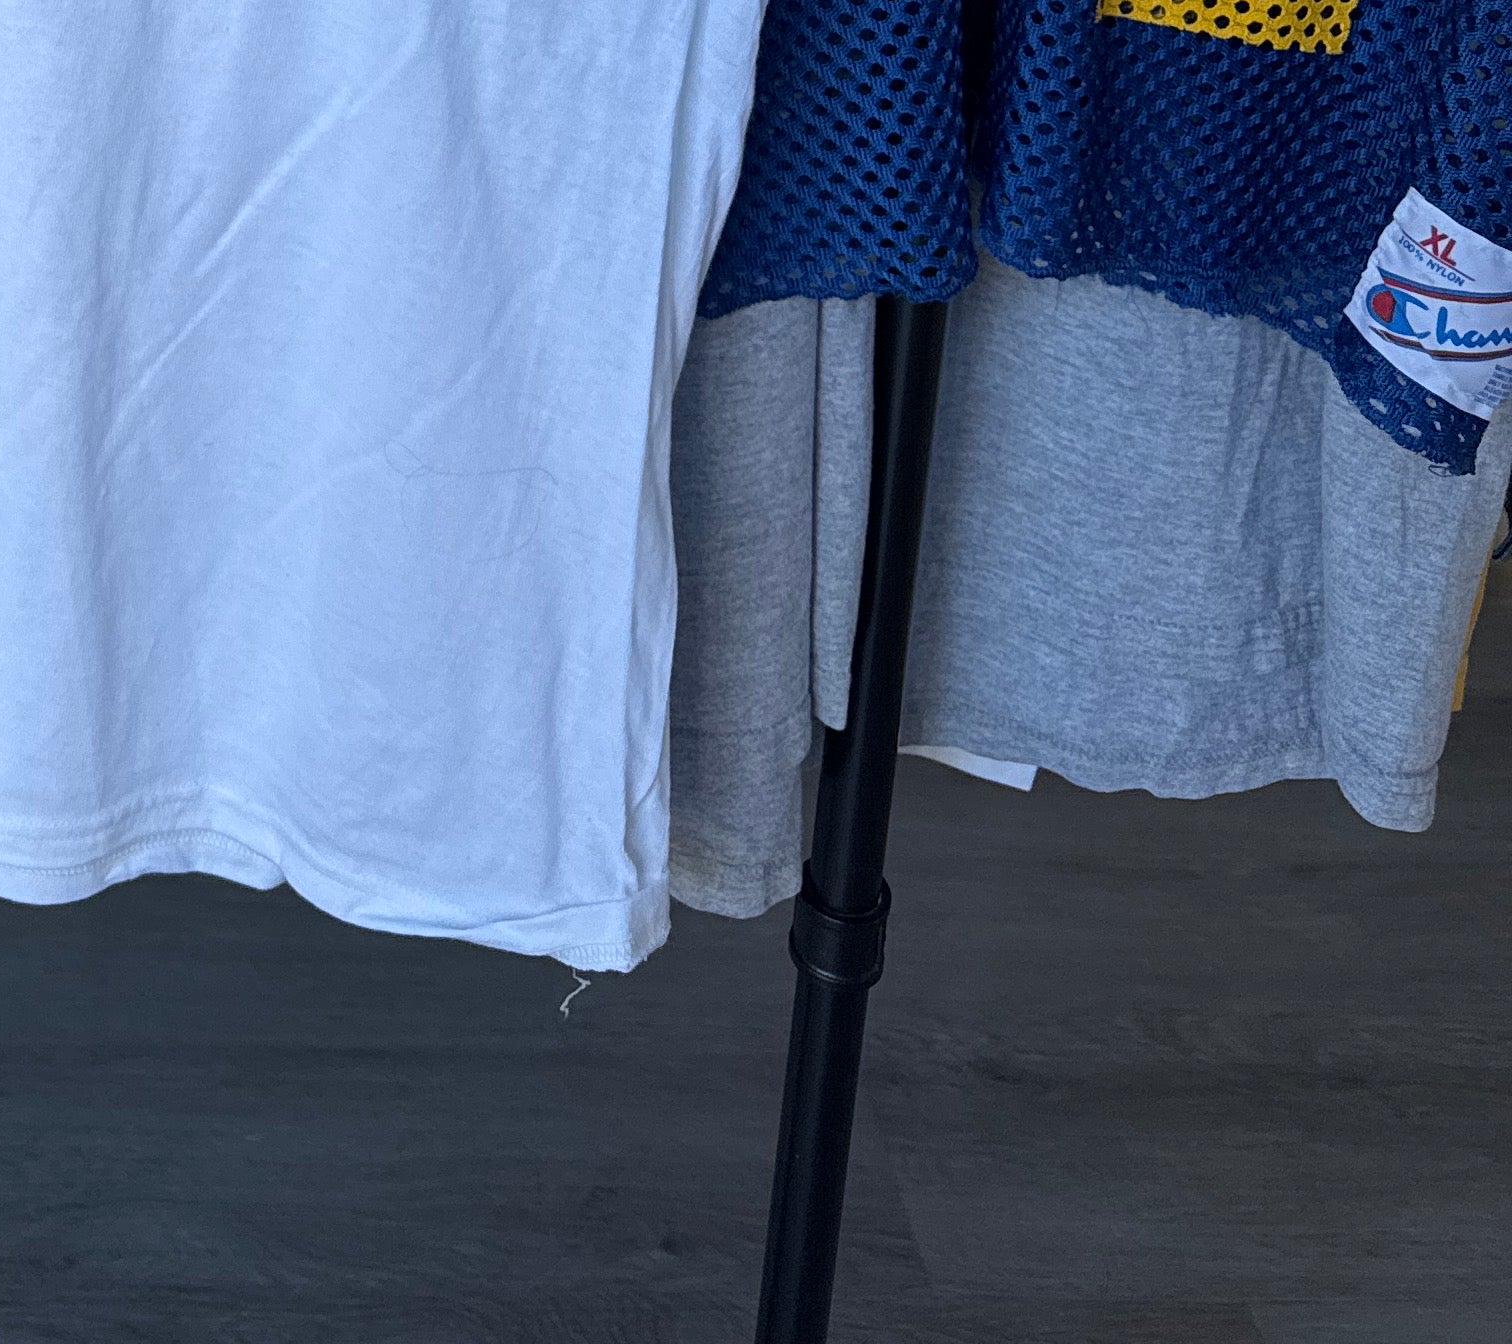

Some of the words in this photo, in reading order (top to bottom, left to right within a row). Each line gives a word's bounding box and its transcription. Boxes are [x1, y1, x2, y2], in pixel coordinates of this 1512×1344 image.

[1398, 235, 1424, 262] 100%
[1426, 258, 1466, 288] NYLON
[1419, 224, 1458, 267] XL
